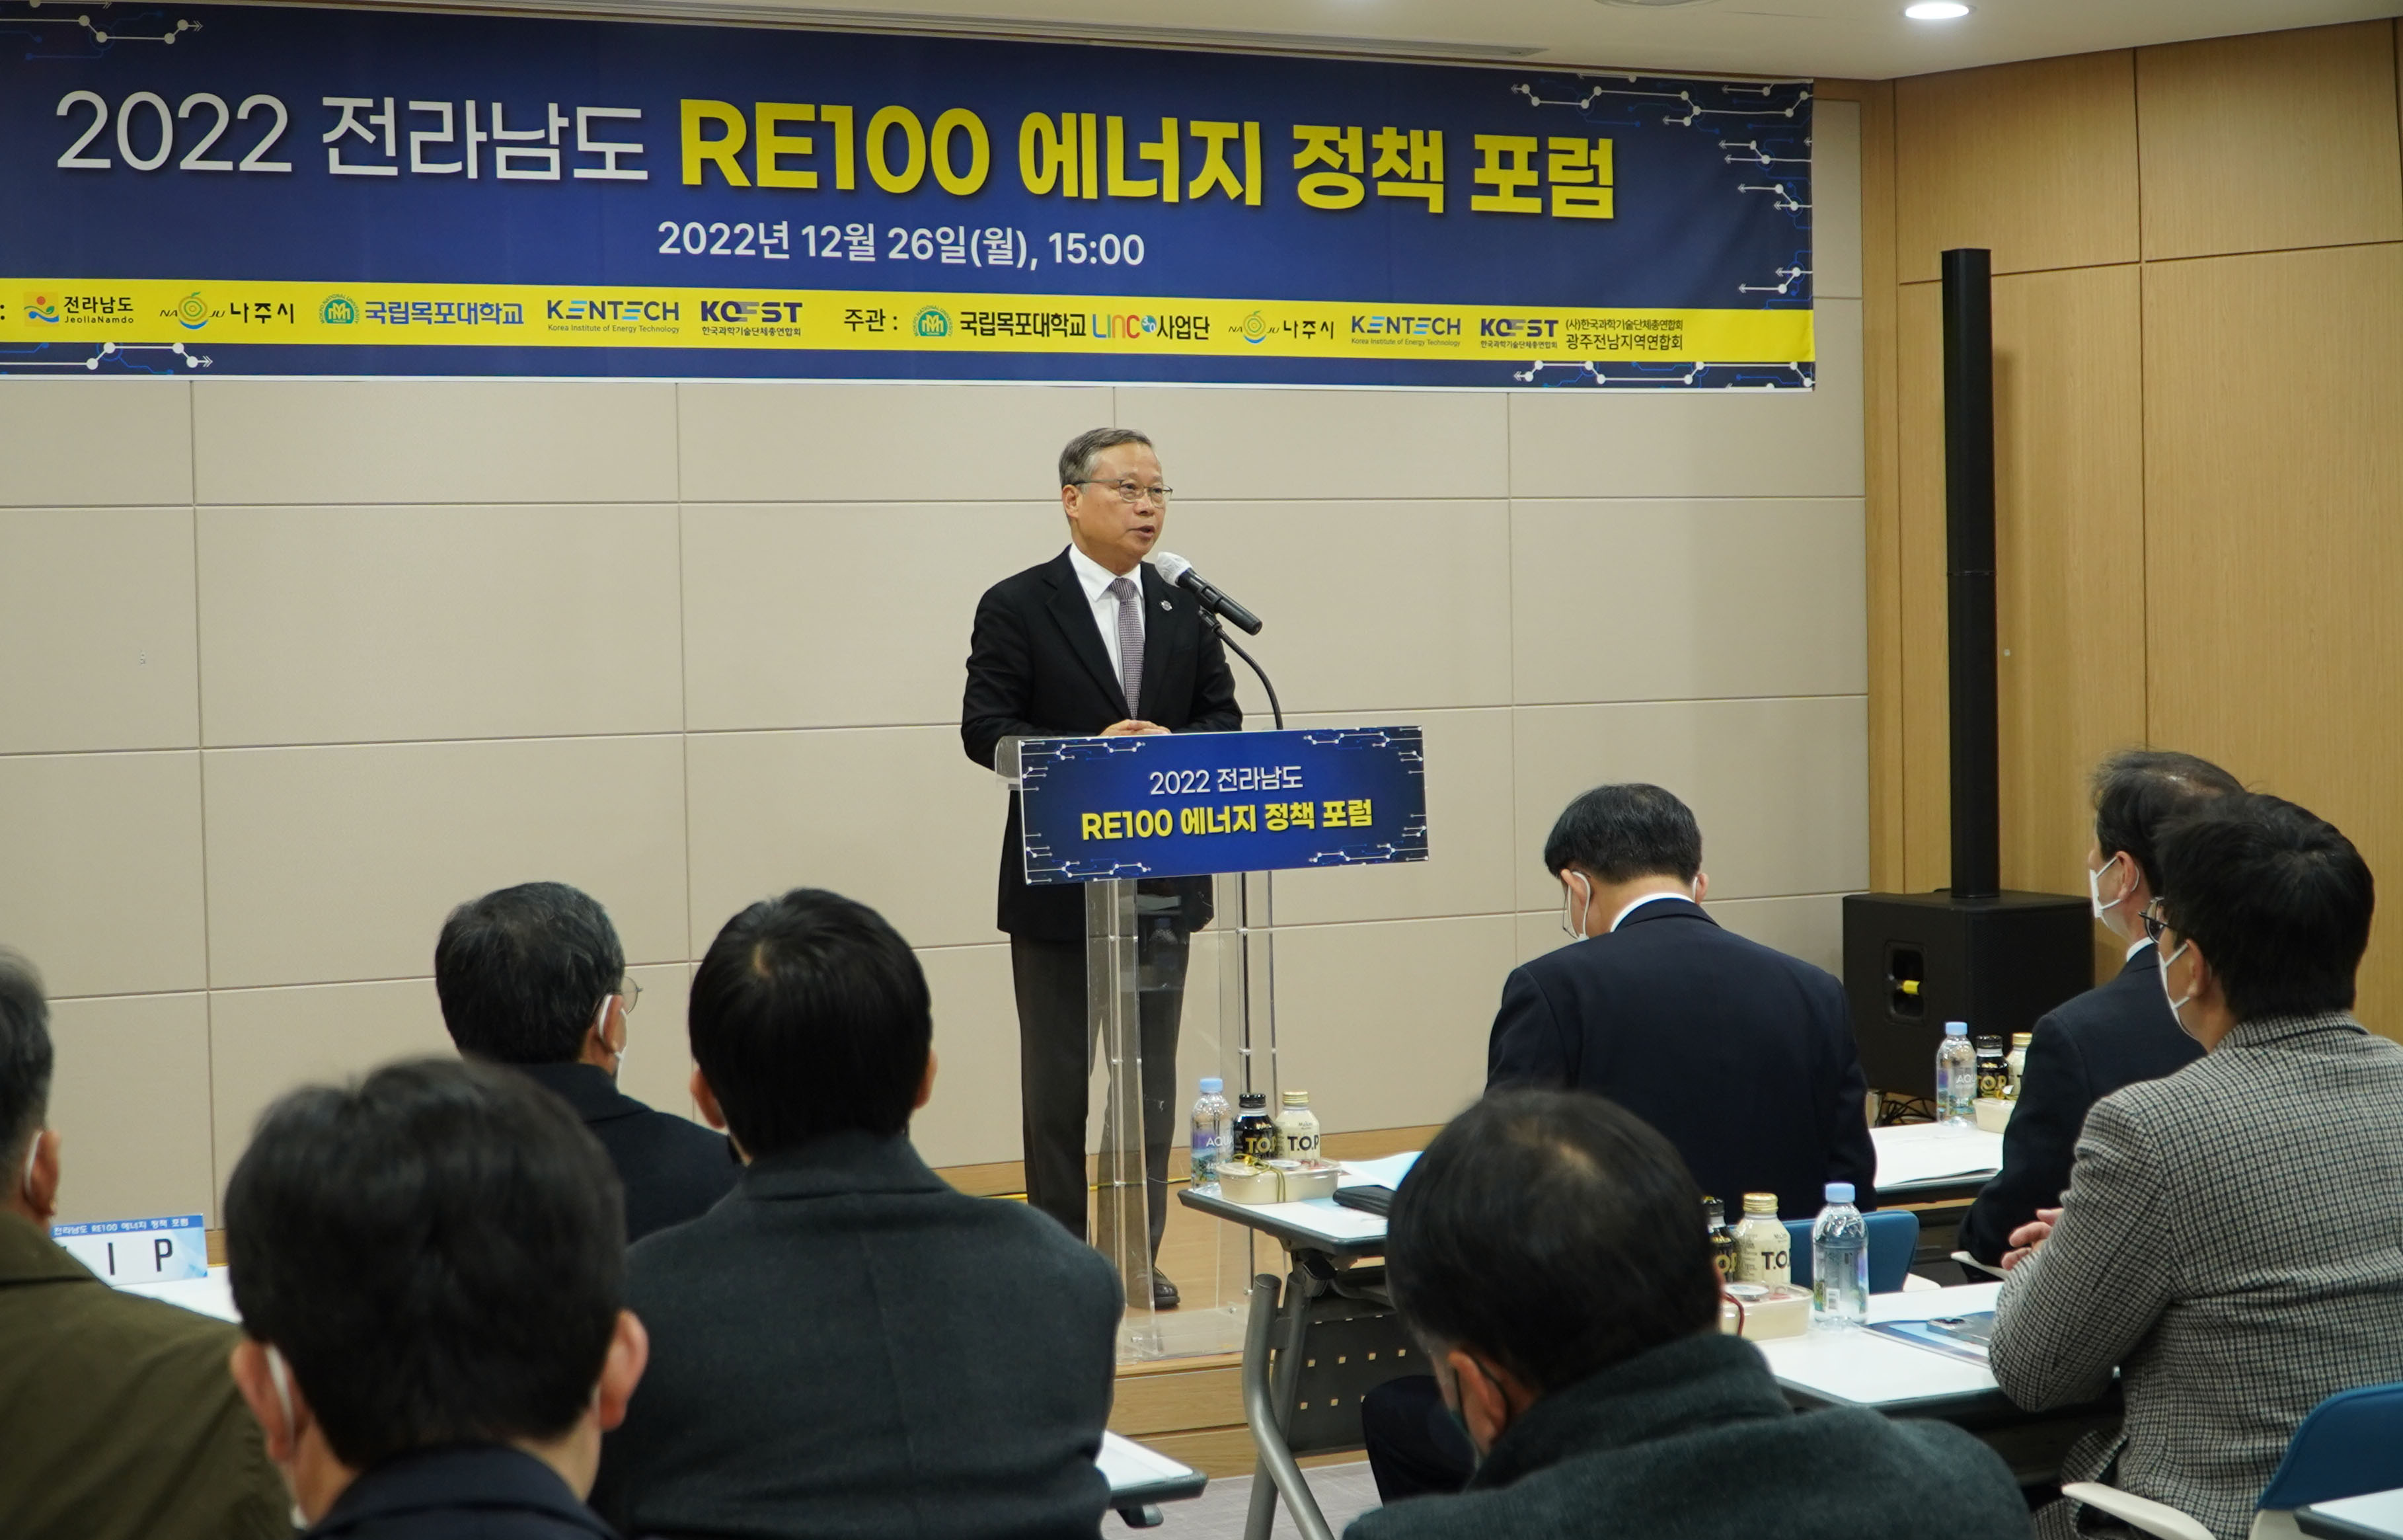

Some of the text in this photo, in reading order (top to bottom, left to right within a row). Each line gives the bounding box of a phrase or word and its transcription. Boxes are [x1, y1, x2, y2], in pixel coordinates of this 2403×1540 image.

[56, 90, 1615, 219] 2022 전라남도 RE100 에너지 정책 포럼
[658, 221, 1145, 271] 2022년 12월 26일(월), 15:00
[63, 295, 134, 314] 전라남도
[230, 302, 295, 325] 나주시
[365, 301, 525, 325] 국립목포대학교
[547, 299, 680, 321] KENTECH
[64, 315, 134, 325] JeollaNamdo
[613, 325, 637, 334] Energy
[639, 325, 681, 335] Technology
[844, 308, 887, 332] 주관
[960, 311, 1085, 338] 국립목포대학교
[1157, 315, 1211, 340] 사업단
[1283, 320, 1335, 340] 나주시
[1352, 315, 1461, 336] KENTECH
[1565, 319, 1684, 332] (사)한국과학기술단체총연합회
[702, 327, 802, 337] 한국과학기술단체총연합회
[1566, 334, 1684, 351] 광주전남지역연합회
[1426, 339, 1461, 348] Technology
[1149, 765, 1303, 795] 2022 전라남도
[1081, 798, 1373, 841] RE100 에너지 정책 포럼
